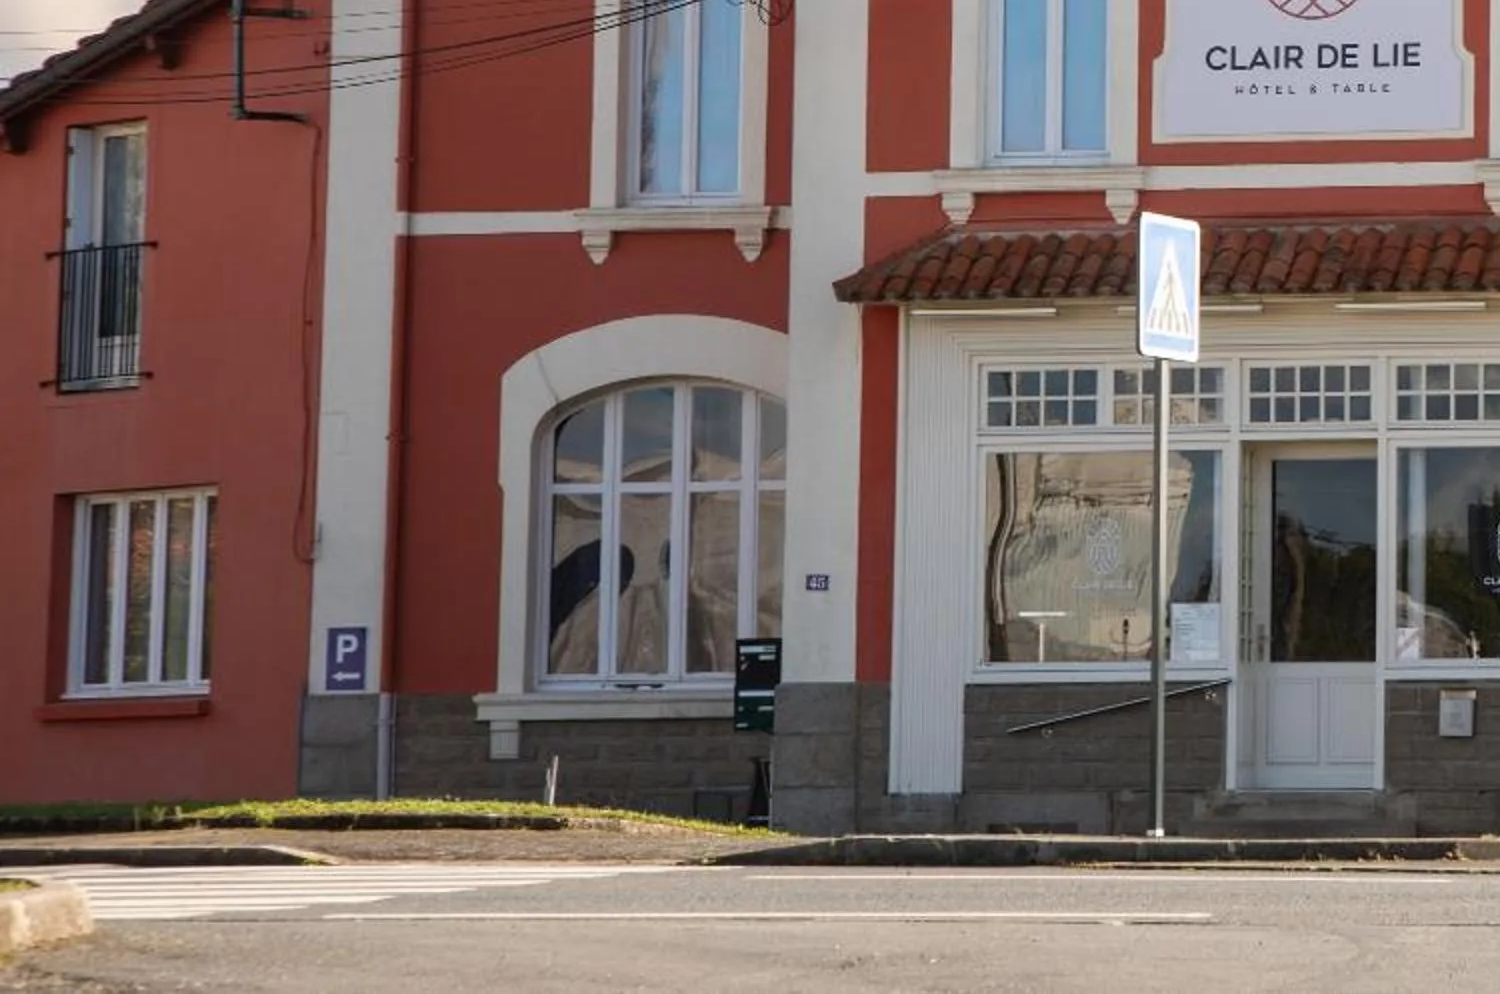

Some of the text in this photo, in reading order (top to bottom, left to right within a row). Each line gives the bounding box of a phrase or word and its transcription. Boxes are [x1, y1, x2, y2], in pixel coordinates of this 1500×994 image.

[1205, 42, 1421, 71] CLAIR DE LIE
[1235, 83, 1297, 95] HÔTEL
[1332, 83, 1391, 94] TABLE
[336, 634, 358, 663] P
